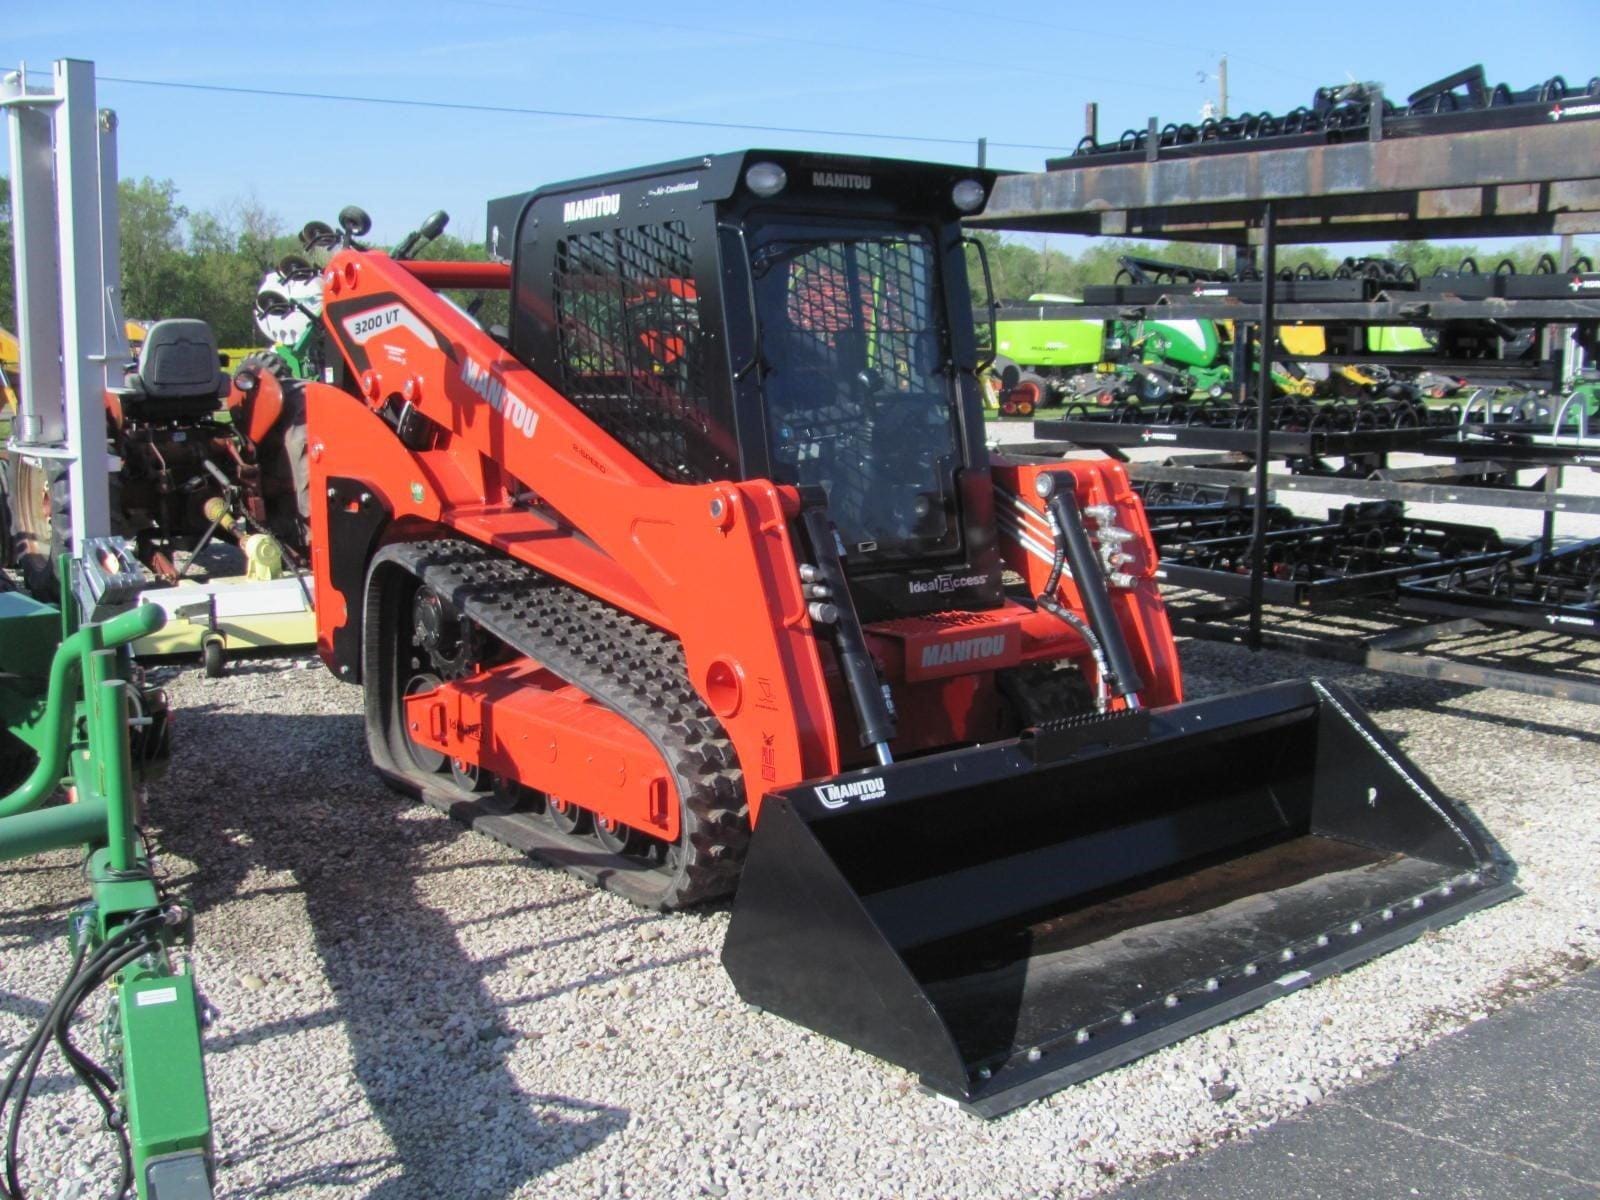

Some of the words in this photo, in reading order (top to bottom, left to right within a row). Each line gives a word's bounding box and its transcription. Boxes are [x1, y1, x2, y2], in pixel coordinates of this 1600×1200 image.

[812, 171, 872, 190] MANITOU
[563, 193, 621, 223] MANITOU
[354, 315, 383, 336] 3200
[385, 308, 400, 325] VT
[461, 356, 540, 439] MANITOU
[921, 634, 1006, 668] MANITOU
[827, 777, 885, 801] MANITOU
[860, 790, 887, 801] GROUP
